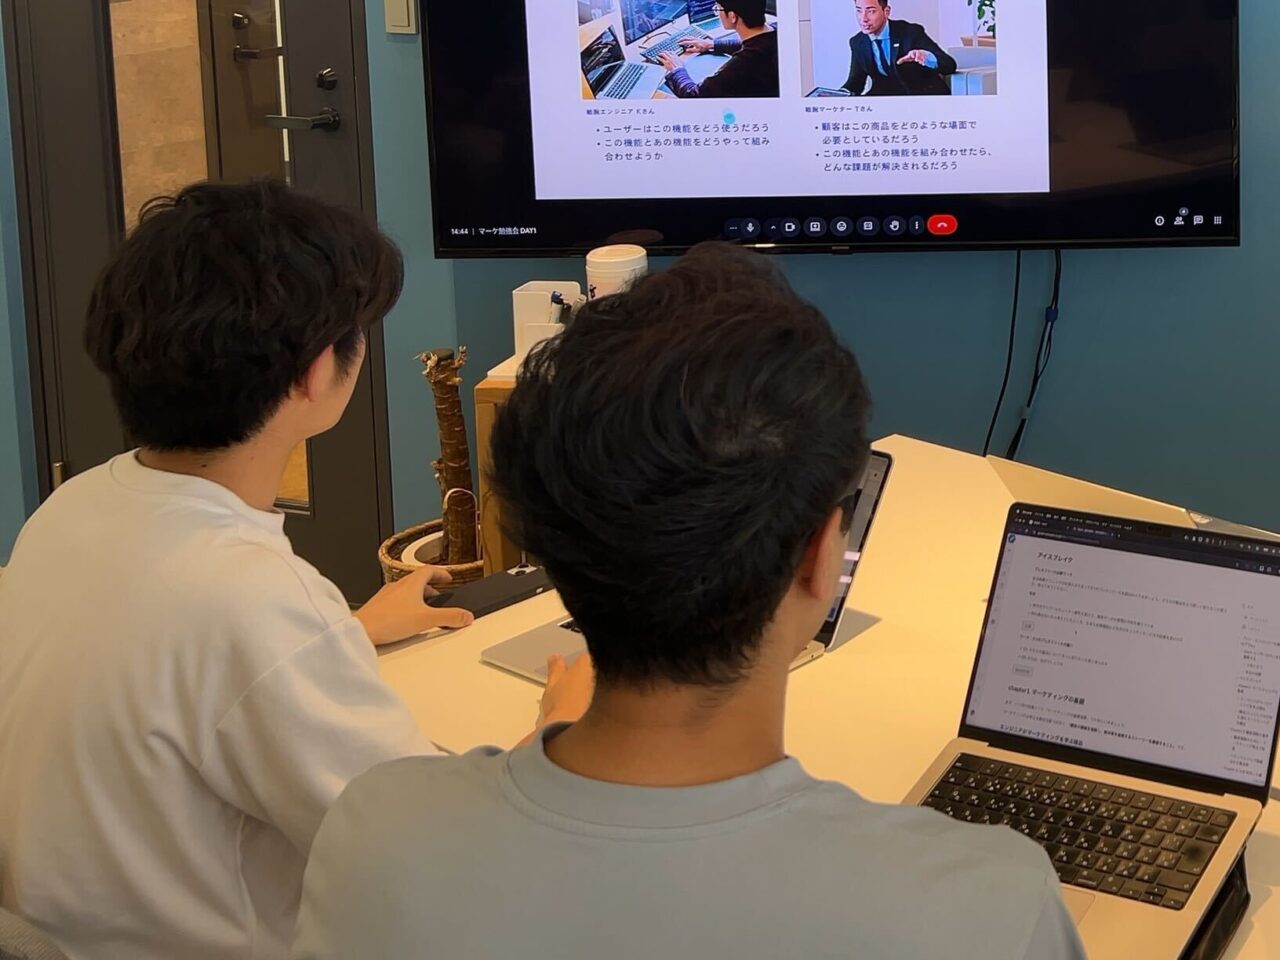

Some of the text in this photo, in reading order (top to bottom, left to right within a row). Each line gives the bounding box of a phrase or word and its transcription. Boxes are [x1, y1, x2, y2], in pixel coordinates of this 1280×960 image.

[603, 123, 770, 134] ユーザーはこの機能をどう使うだろう
[821, 121, 977, 131] 顧客はこの商品をどのような場面で
[604, 137, 770, 147] この機能とあの機能をどうやって組み
[822, 135, 919, 144] 必要としているだろう
[605, 152, 664, 162] 合わせようか
[823, 147, 992, 158] この機能とあの機能を組み合わせたら、
[823, 162, 958, 172] どんな課題が解決されるだろう
